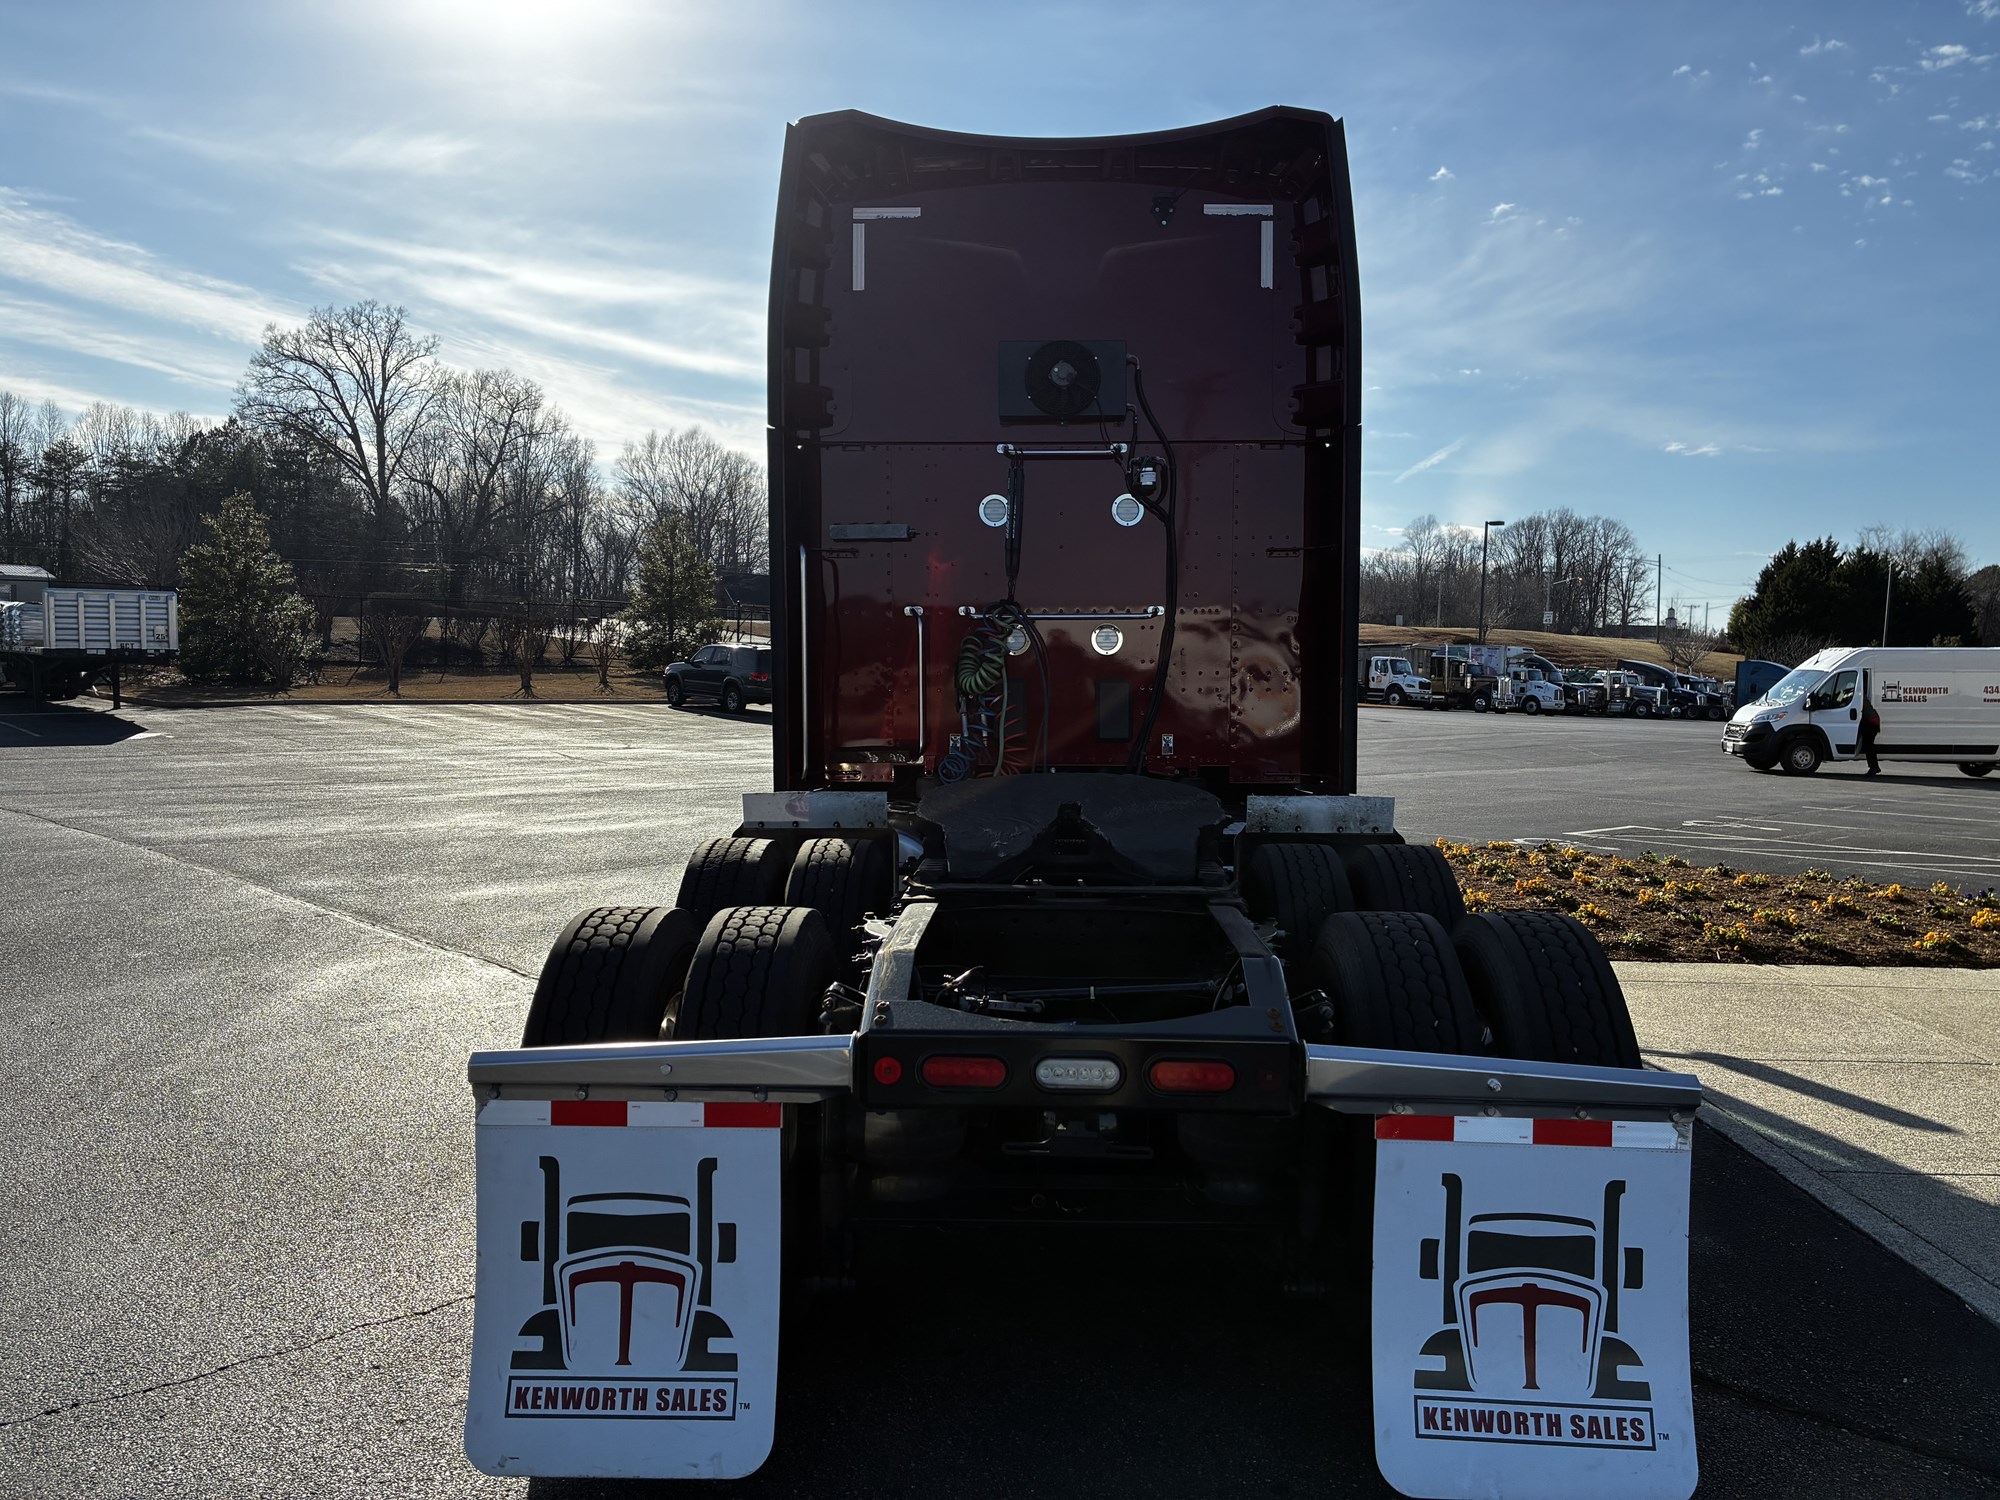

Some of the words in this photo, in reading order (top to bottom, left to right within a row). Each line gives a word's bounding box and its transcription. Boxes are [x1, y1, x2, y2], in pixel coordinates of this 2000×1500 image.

[1902, 687, 1949, 695] KENWORTH
[1902, 695, 1928, 703] SALES
[514, 1386, 648, 1411] KENWORTH
[655, 1388, 727, 1413] SALES
[1423, 1406, 1562, 1437] KENWORTH
[1569, 1414, 1646, 1442] SALES
